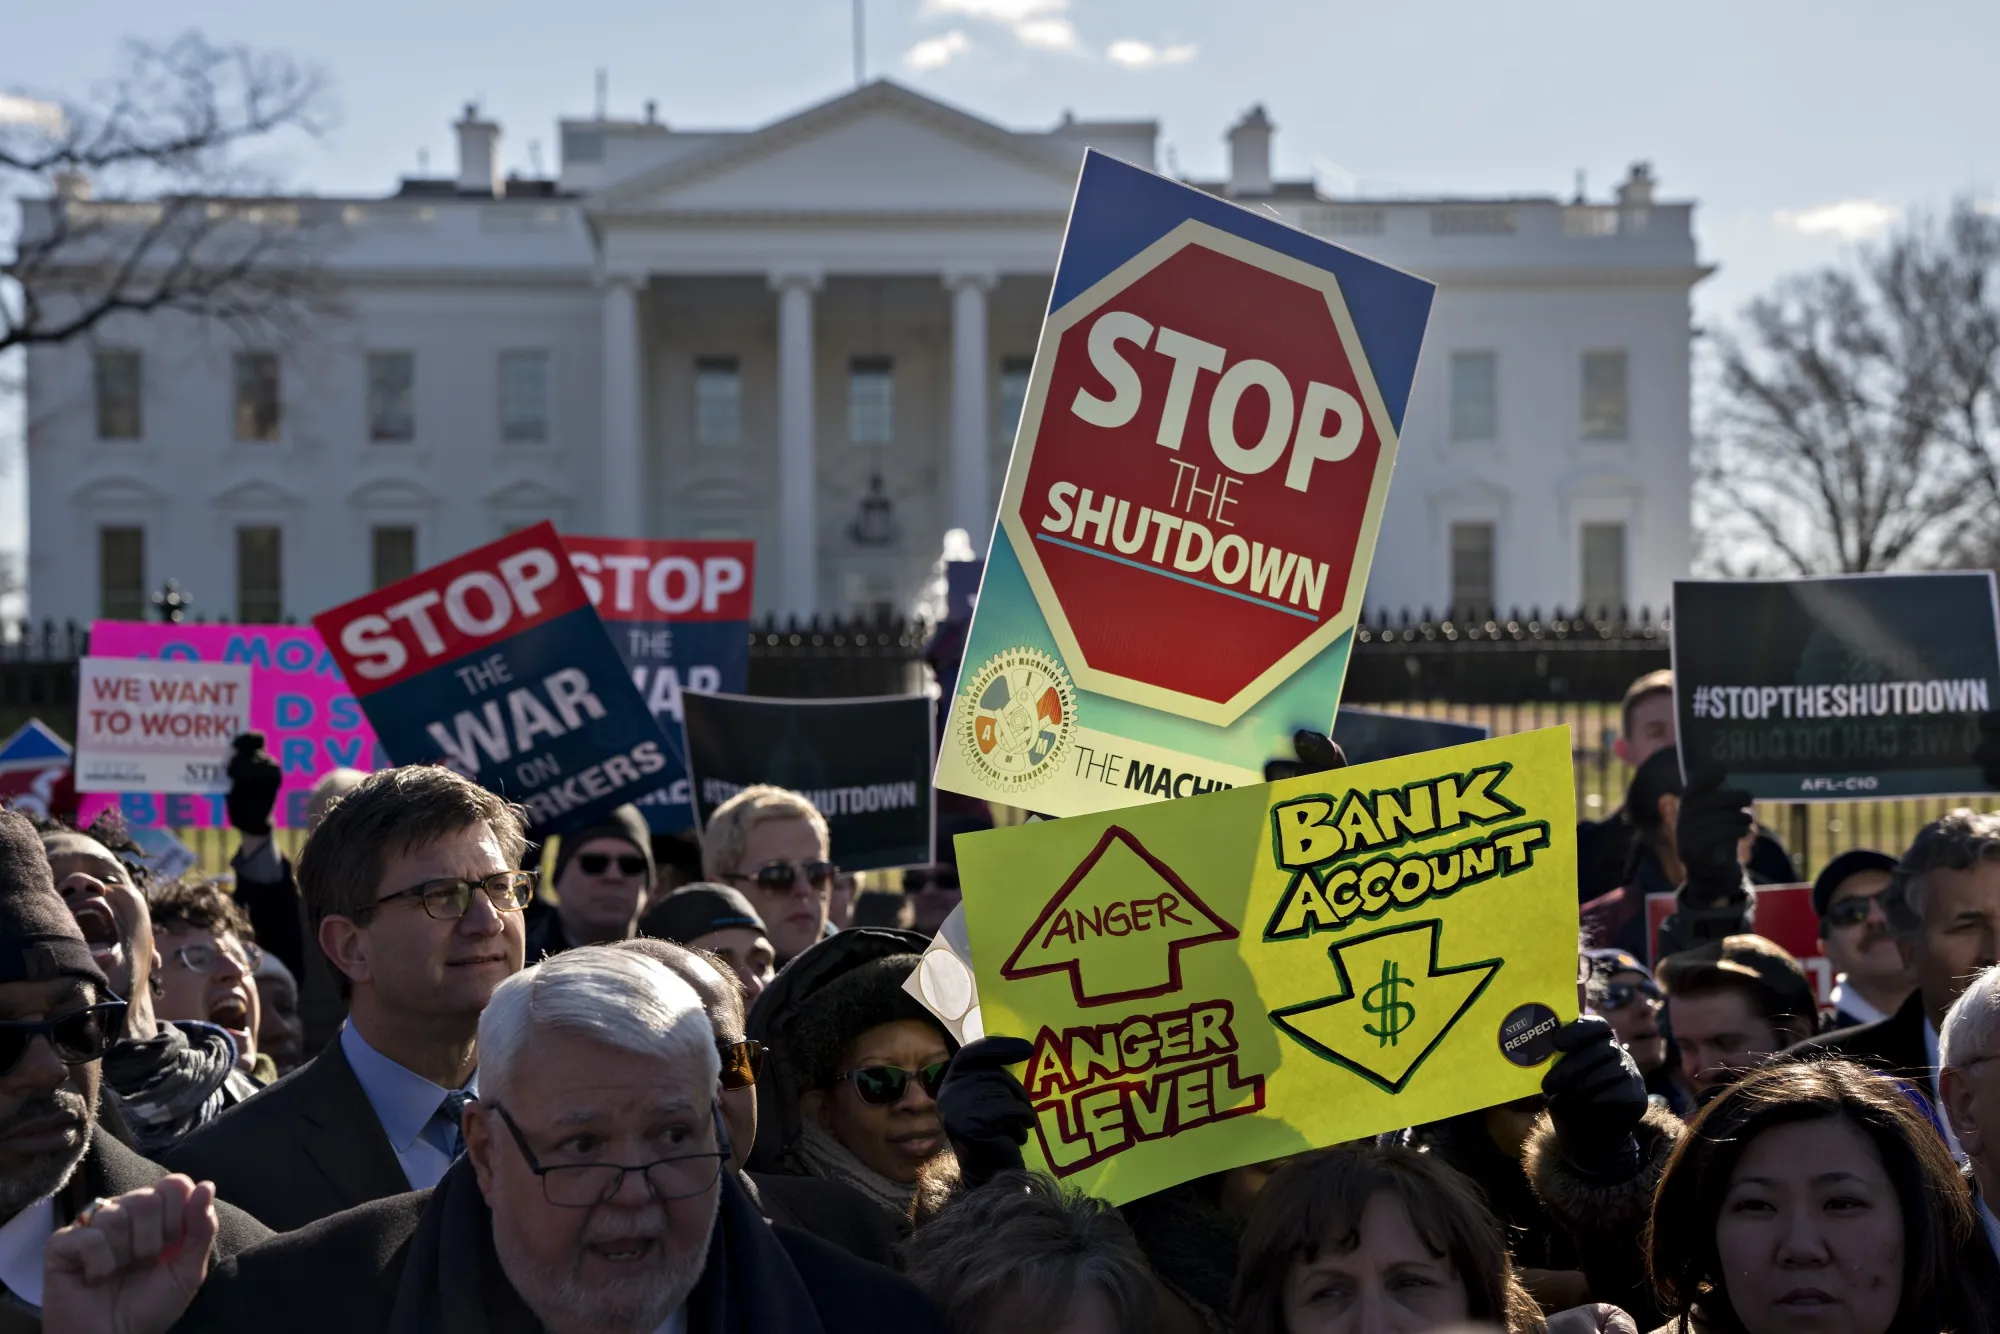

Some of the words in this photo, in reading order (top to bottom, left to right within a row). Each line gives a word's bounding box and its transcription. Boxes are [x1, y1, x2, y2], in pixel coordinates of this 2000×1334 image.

[1071, 311, 1363, 493] STOP
[1169, 458, 1243, 526] THE
[1040, 481, 1329, 611] SHUTDOWN
[341, 548, 559, 679] STOP
[627, 630, 674, 659] THE
[1006, 658, 1015, 668] OF
[93, 677, 142, 702] WE
[150, 679, 240, 706] WANT
[454, 653, 514, 696] THE
[967, 664, 1003, 716] ASSOCIATION
[1018, 657, 1062, 688] MACHINISTS
[426, 667, 608, 774] WAR
[1058, 688, 1069, 708] AND
[1692, 678, 1990, 719] #STOPTHESHUTDOWN
[90, 709, 132, 734] TO
[140, 712, 240, 739] WORK!
[1048, 710, 1070, 763] AEROSPACE
[516, 752, 561, 788] ON
[966, 721, 1001, 780] INTERNATIONAL
[1012, 764, 1050, 783] WORKERS
[1075, 745, 1123, 786] THE
[527, 742, 666, 824] RKERS
[1800, 775, 1879, 792] AFL-CIO
[1270, 762, 1526, 871] BANK
[1262, 820, 1550, 943] ACCOUNT
[1041, 893, 1193, 949] ANGER
[1023, 999, 1239, 1101] ANGER
[1504, 1017, 1556, 1052] RESPECT
[1505, 1018, 1529, 1035] NTEU
[1034, 1054, 1266, 1179] LEVEL
